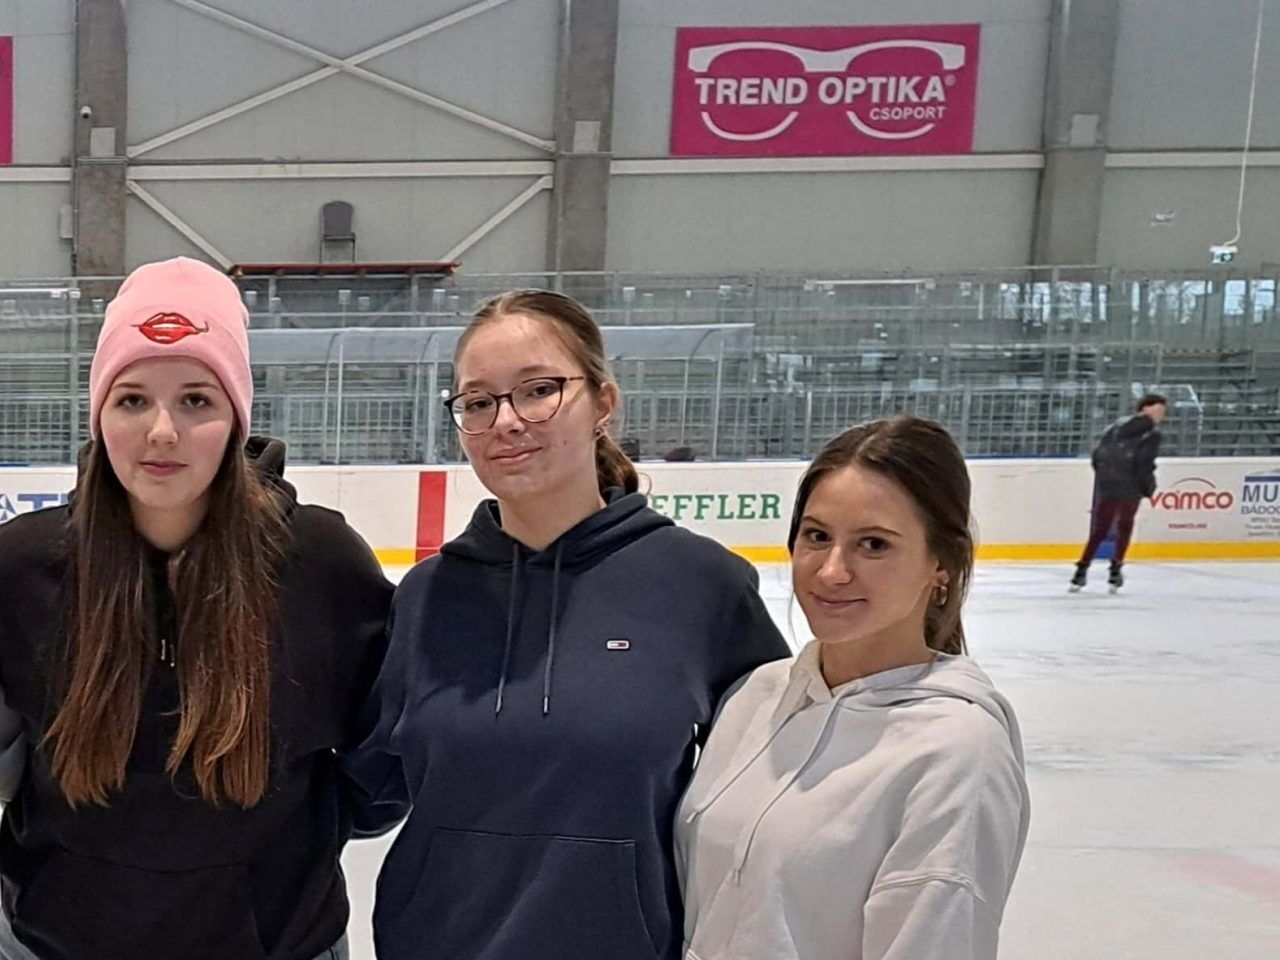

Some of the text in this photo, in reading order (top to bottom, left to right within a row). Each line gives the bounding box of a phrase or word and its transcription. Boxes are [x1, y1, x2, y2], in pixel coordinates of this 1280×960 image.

[695, 77, 808, 105] TREND
[870, 106, 947, 120] CSOPORT
[1241, 485, 1280, 503] MU
[650, 494, 781, 520] EFFLER
